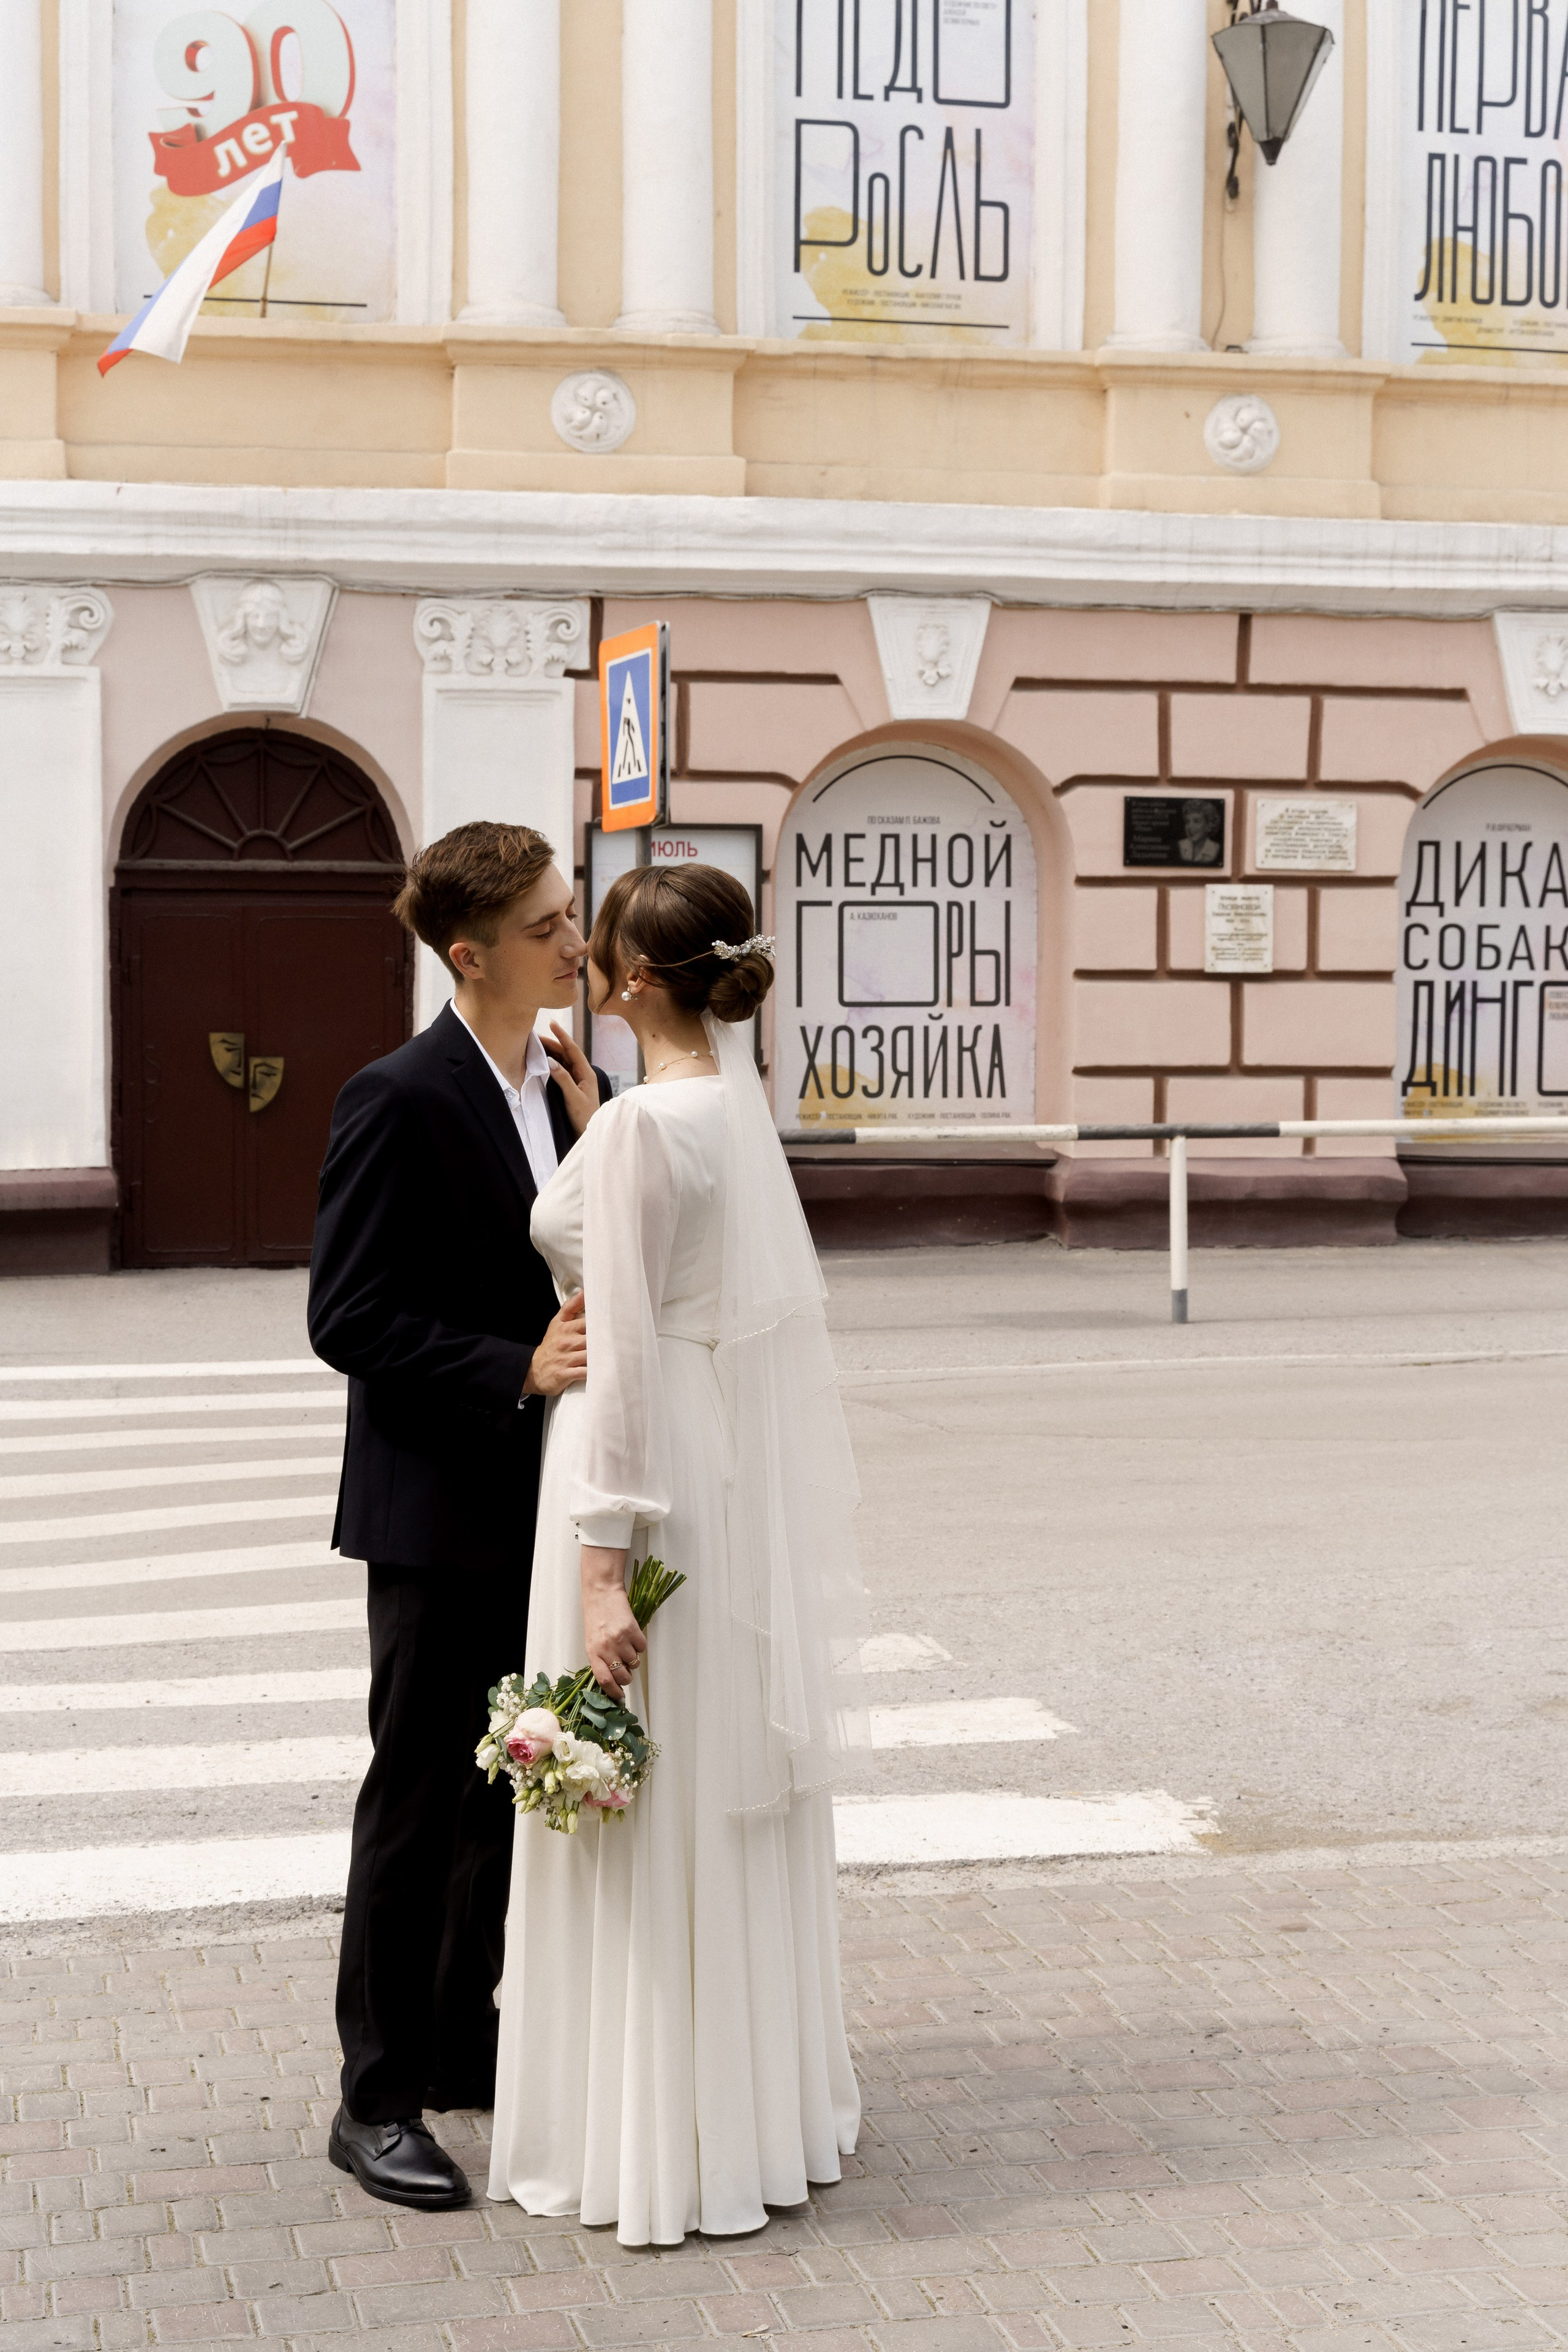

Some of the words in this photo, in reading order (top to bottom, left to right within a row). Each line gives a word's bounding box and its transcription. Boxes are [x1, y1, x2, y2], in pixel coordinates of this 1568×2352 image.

[153, 0, 356, 137] 90
[213, 110, 299, 178] лет
[794, 118, 1009, 282] РОСЛЬ
[1414, 152, 1568, 309] ЛЮБО
[795, 820, 1012, 896] МЕДНОЙ
[795, 900, 1012, 1008] ГОРЫ
[1403, 923, 1568, 971] СОБАК
[798, 1013, 1006, 1099] ХОЗЯЙКА
